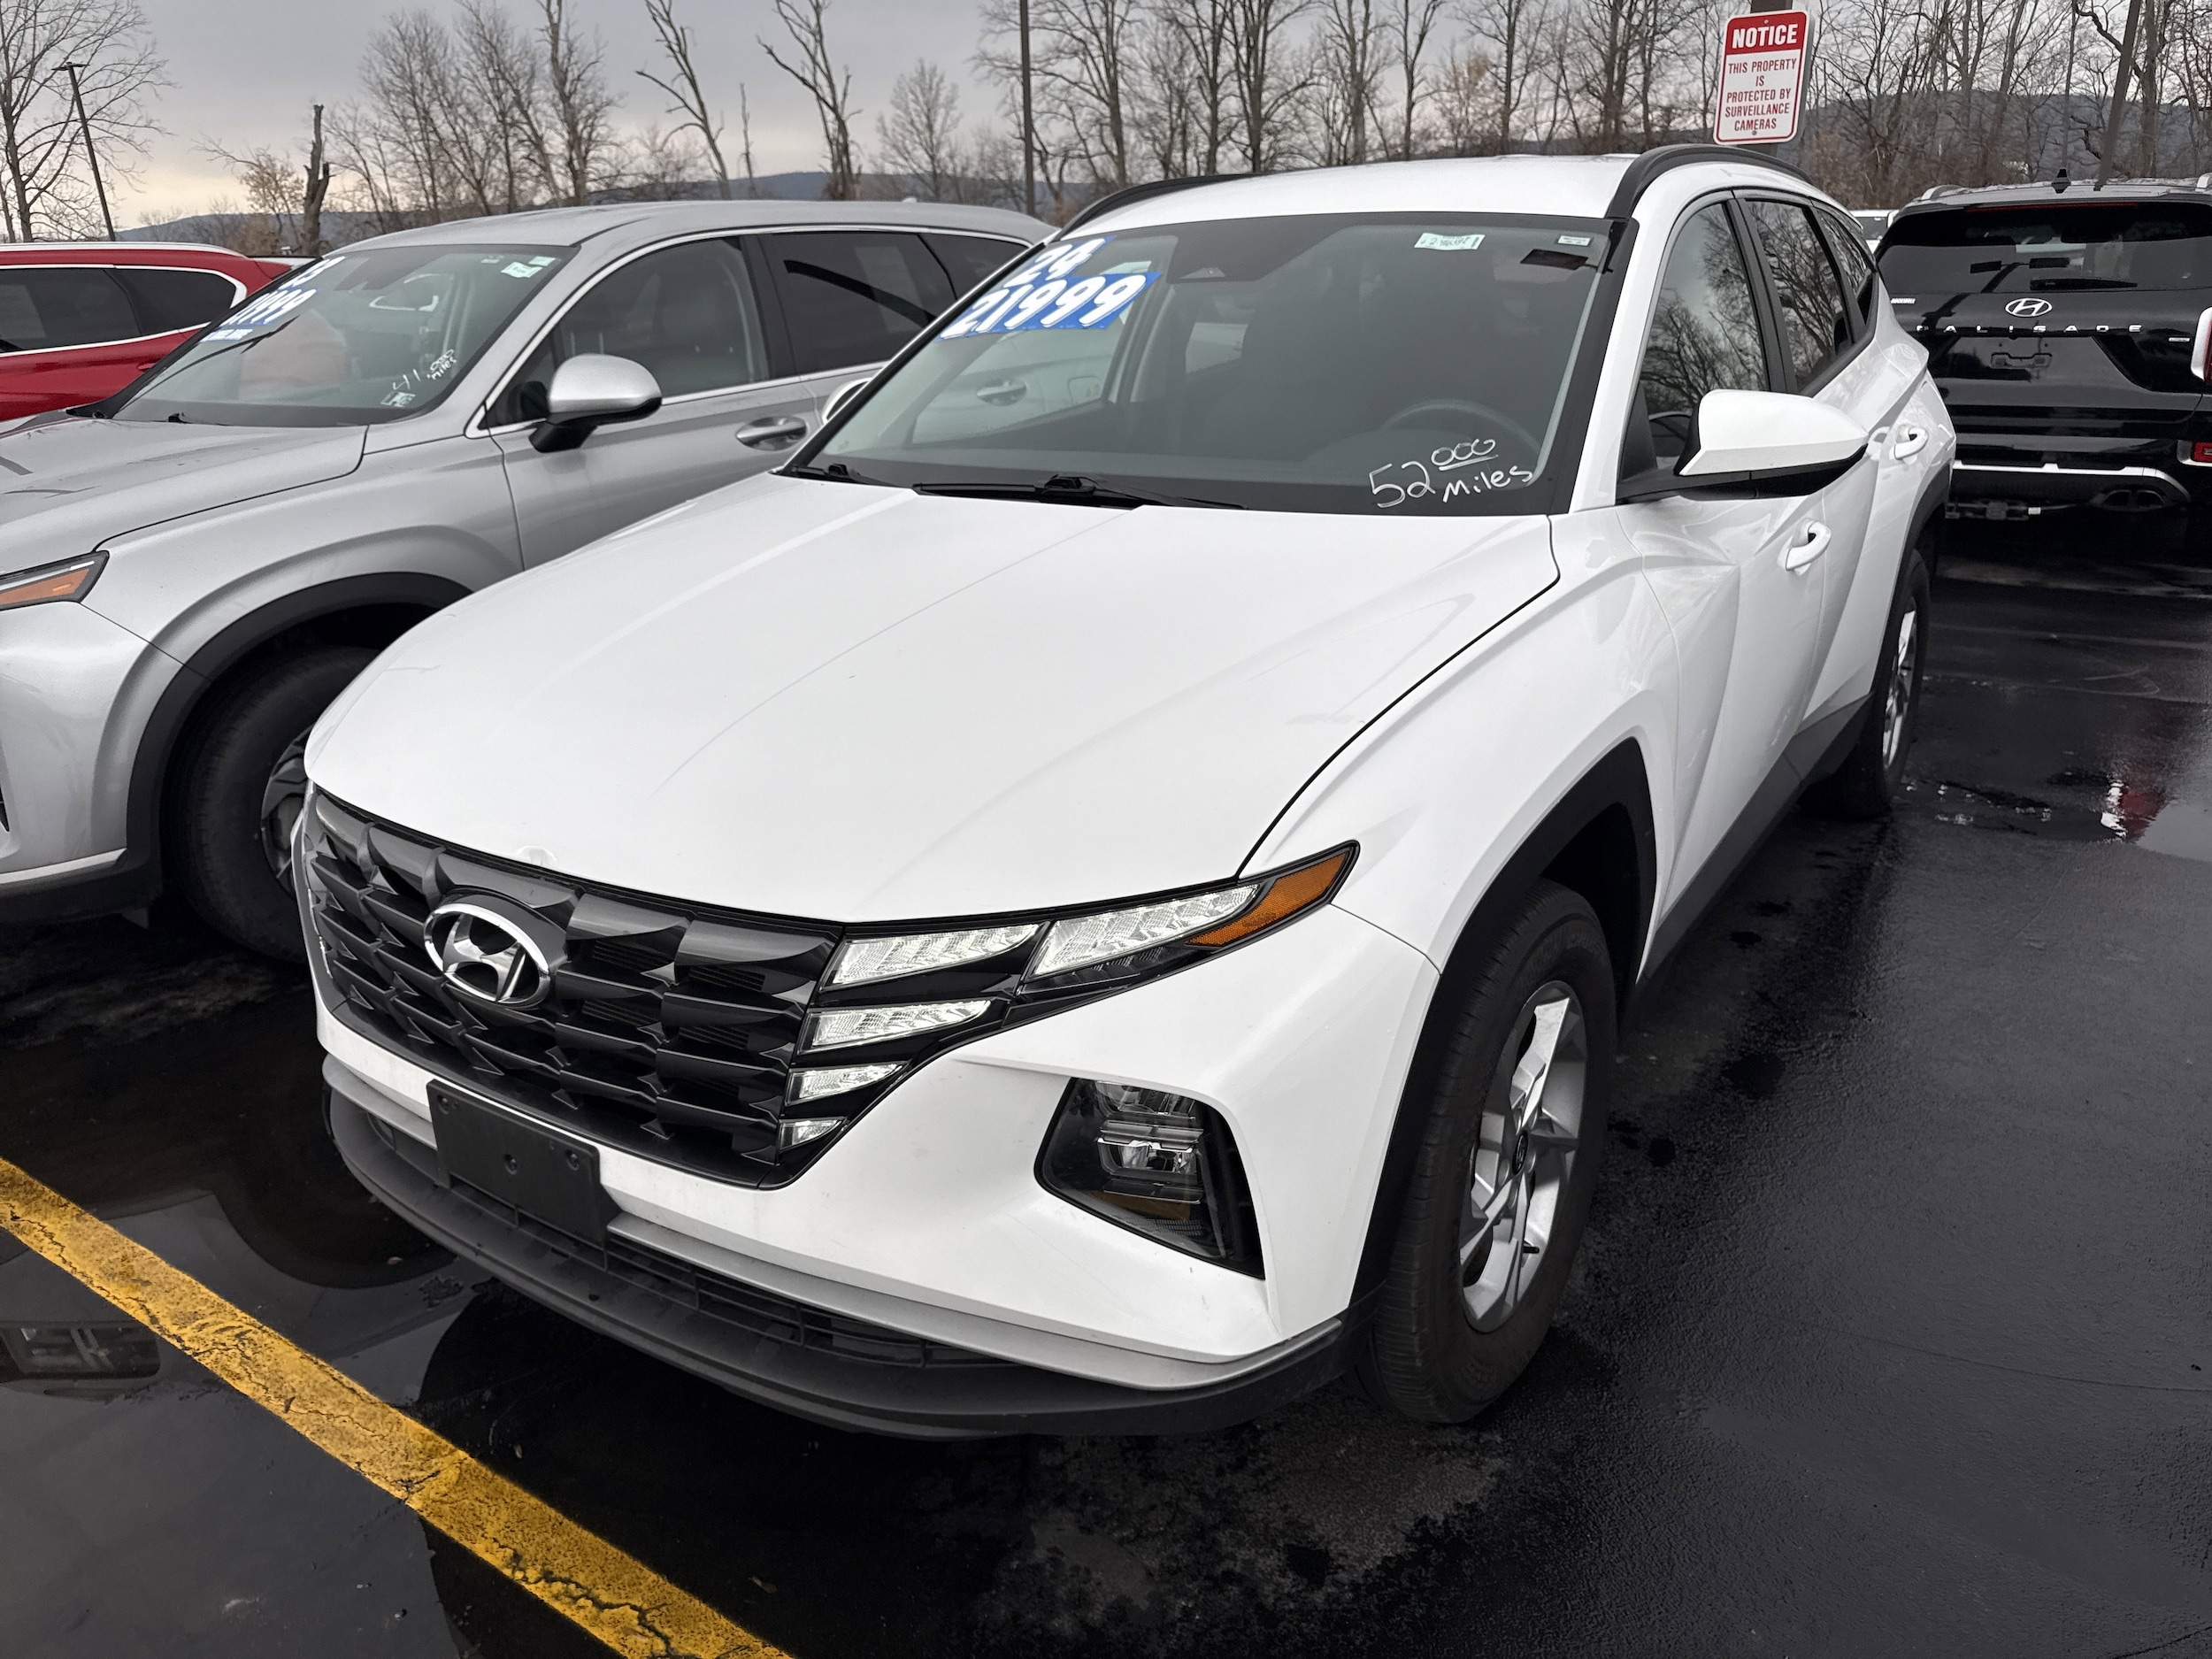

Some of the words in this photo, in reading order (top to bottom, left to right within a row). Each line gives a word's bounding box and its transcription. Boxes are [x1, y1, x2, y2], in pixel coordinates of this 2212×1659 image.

[1732, 24, 1798, 49] NOTICE
[1729, 62, 1747, 73] THIS
[1751, 58, 1797, 73] PROPERTY
[1755, 75, 1764, 87] IS
[1726, 90, 1776, 104] PROTECTED
[1780, 88, 1791, 99] BY
[1724, 103, 1790, 118] SURVEILLANCE
[1734, 119, 1777, 131] CAMERAS
[940, 274, 1147, 339] 21999
[1916, 324, 2142, 334] PALISADE
